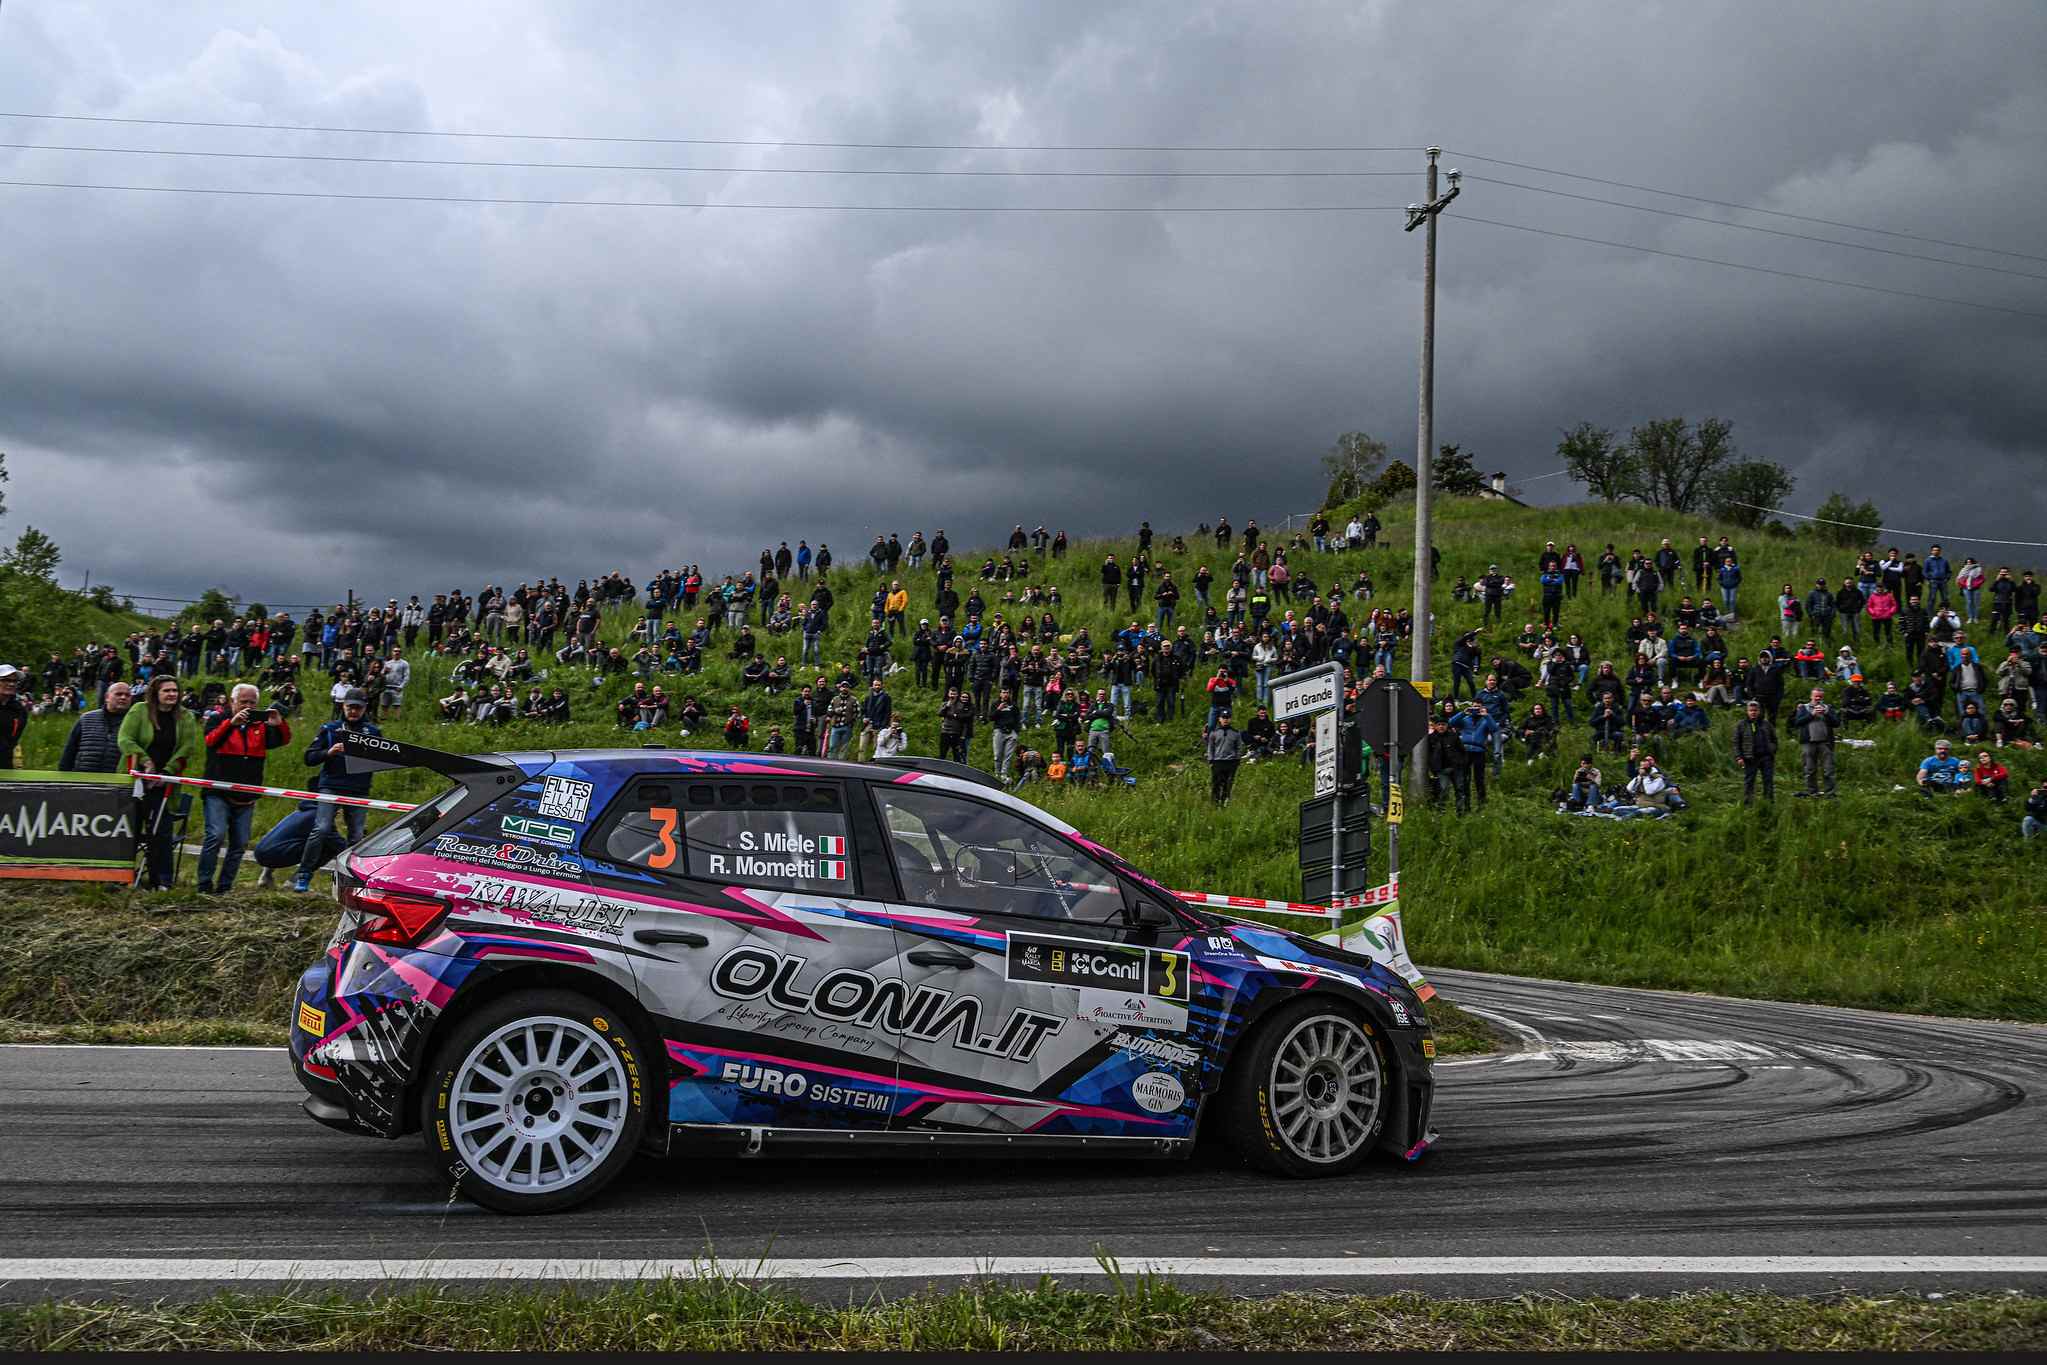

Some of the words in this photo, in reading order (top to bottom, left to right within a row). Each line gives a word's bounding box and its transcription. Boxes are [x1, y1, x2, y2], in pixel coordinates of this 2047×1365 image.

[1301, 688, 1333, 706] Grande
[546, 777, 591, 798] FILTES
[543, 791, 588, 811] FILATI
[501, 816, 575, 844] MPG
[648, 808, 677, 869] 3
[739, 831, 759, 851] S.
[765, 833, 816, 853] Miele
[435, 834, 584, 873] Rent&Drive
[453, 854, 478, 864] esperti
[491, 859, 522, 870] Noleggio
[529, 866, 550, 875] Lungo
[552, 870, 581, 880] Termine
[710, 855, 731, 874] R.
[736, 856, 816, 878] Mometti
[466, 880, 638, 928] KIWA-JET
[1090, 955, 1140, 980] Canil
[1159, 952, 1177, 996] 3
[774, 1015, 817, 1039] Group
[818, 1025, 875, 1051] Company
[721, 1062, 808, 1097] EURO
[809, 1084, 890, 1111] SISTEMI
[1136, 1082, 1181, 1101] MARMORIS
[1147, 1098, 1165, 1111] GIN
